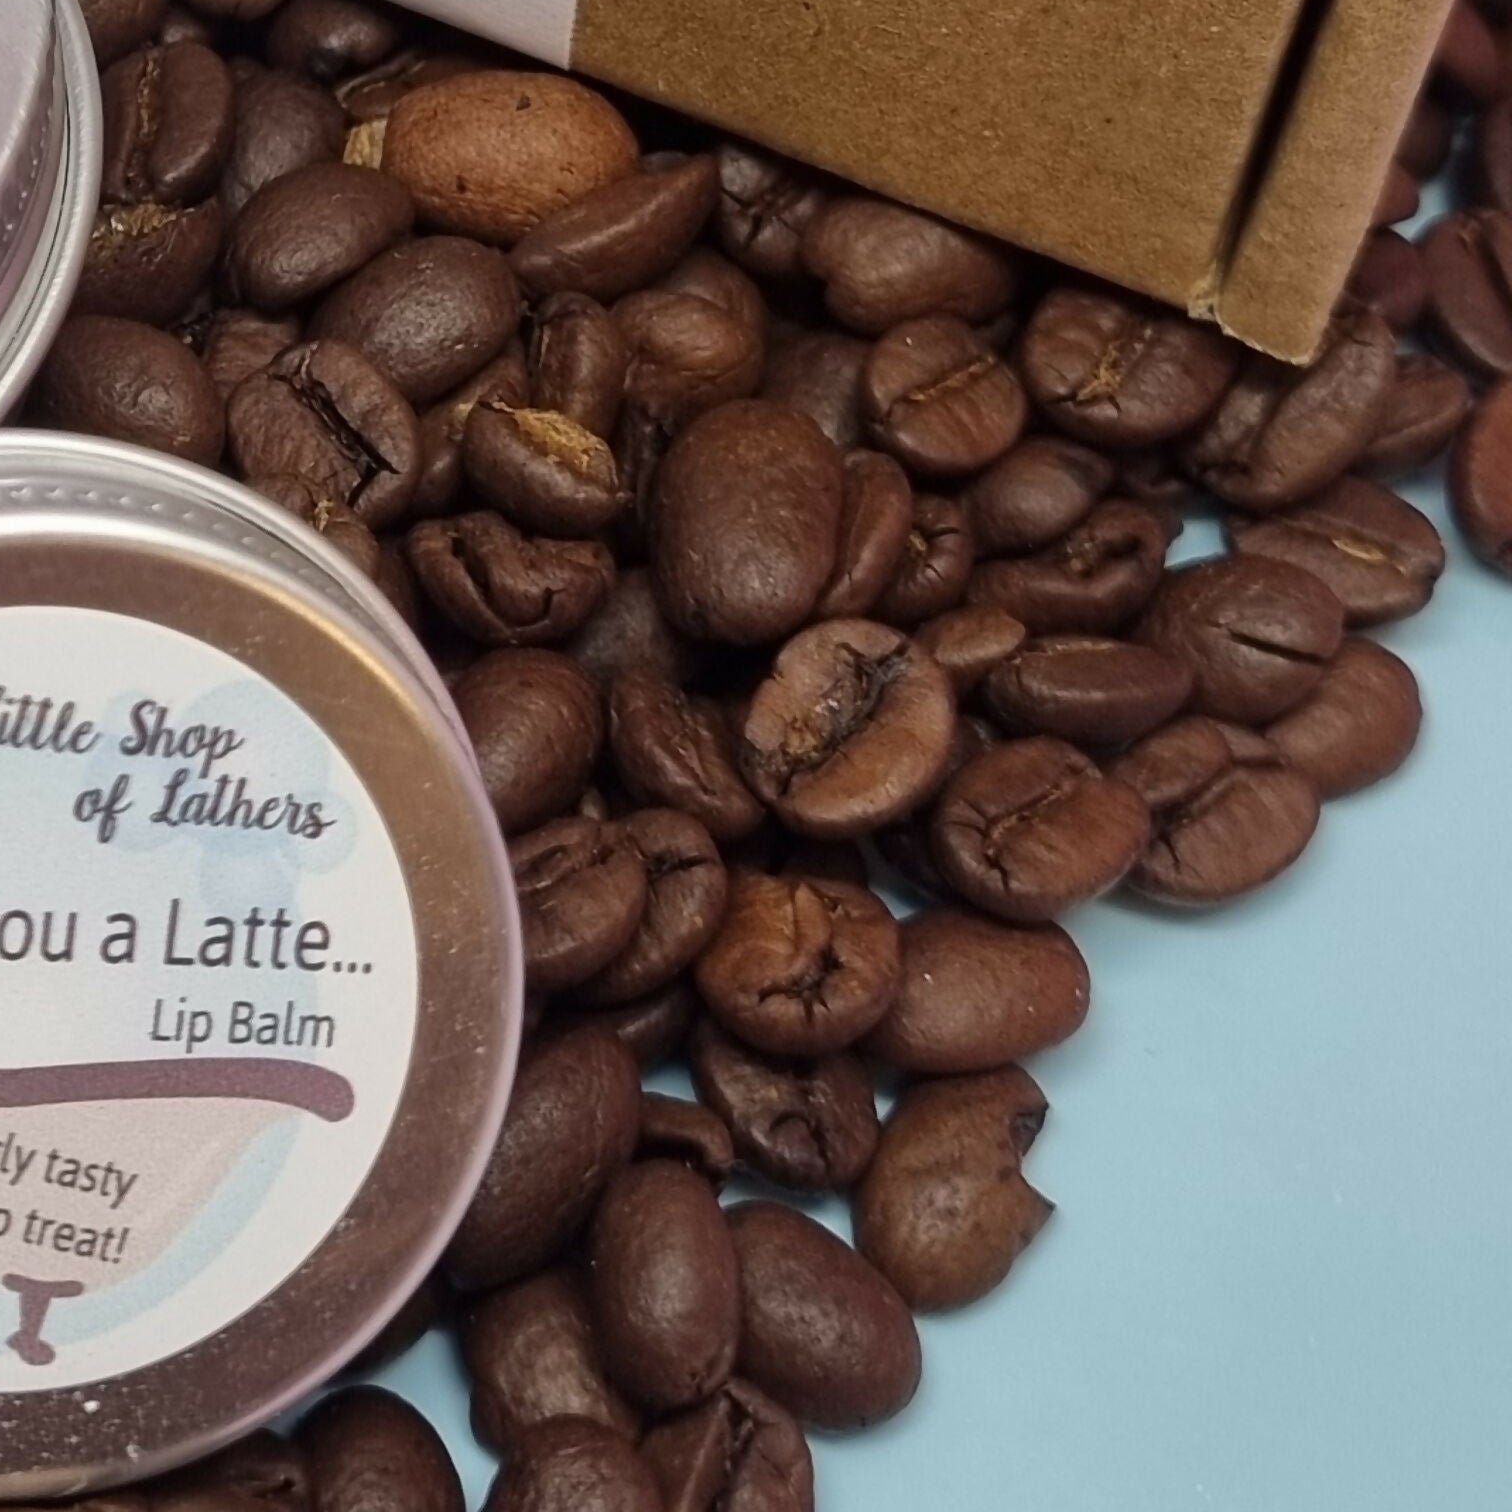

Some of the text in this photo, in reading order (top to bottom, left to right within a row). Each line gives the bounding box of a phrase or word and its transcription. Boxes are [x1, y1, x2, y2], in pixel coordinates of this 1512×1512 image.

[119, 700, 244, 779] Shop
[73, 768, 336, 843] of Lathers
[101, 913, 136, 964] a
[164, 899, 371, 973] Latte...
[149, 997, 334, 1053] Lip Balm
[44, 1149, 138, 1209] tasty
[23, 1210, 129, 1263] treat!
